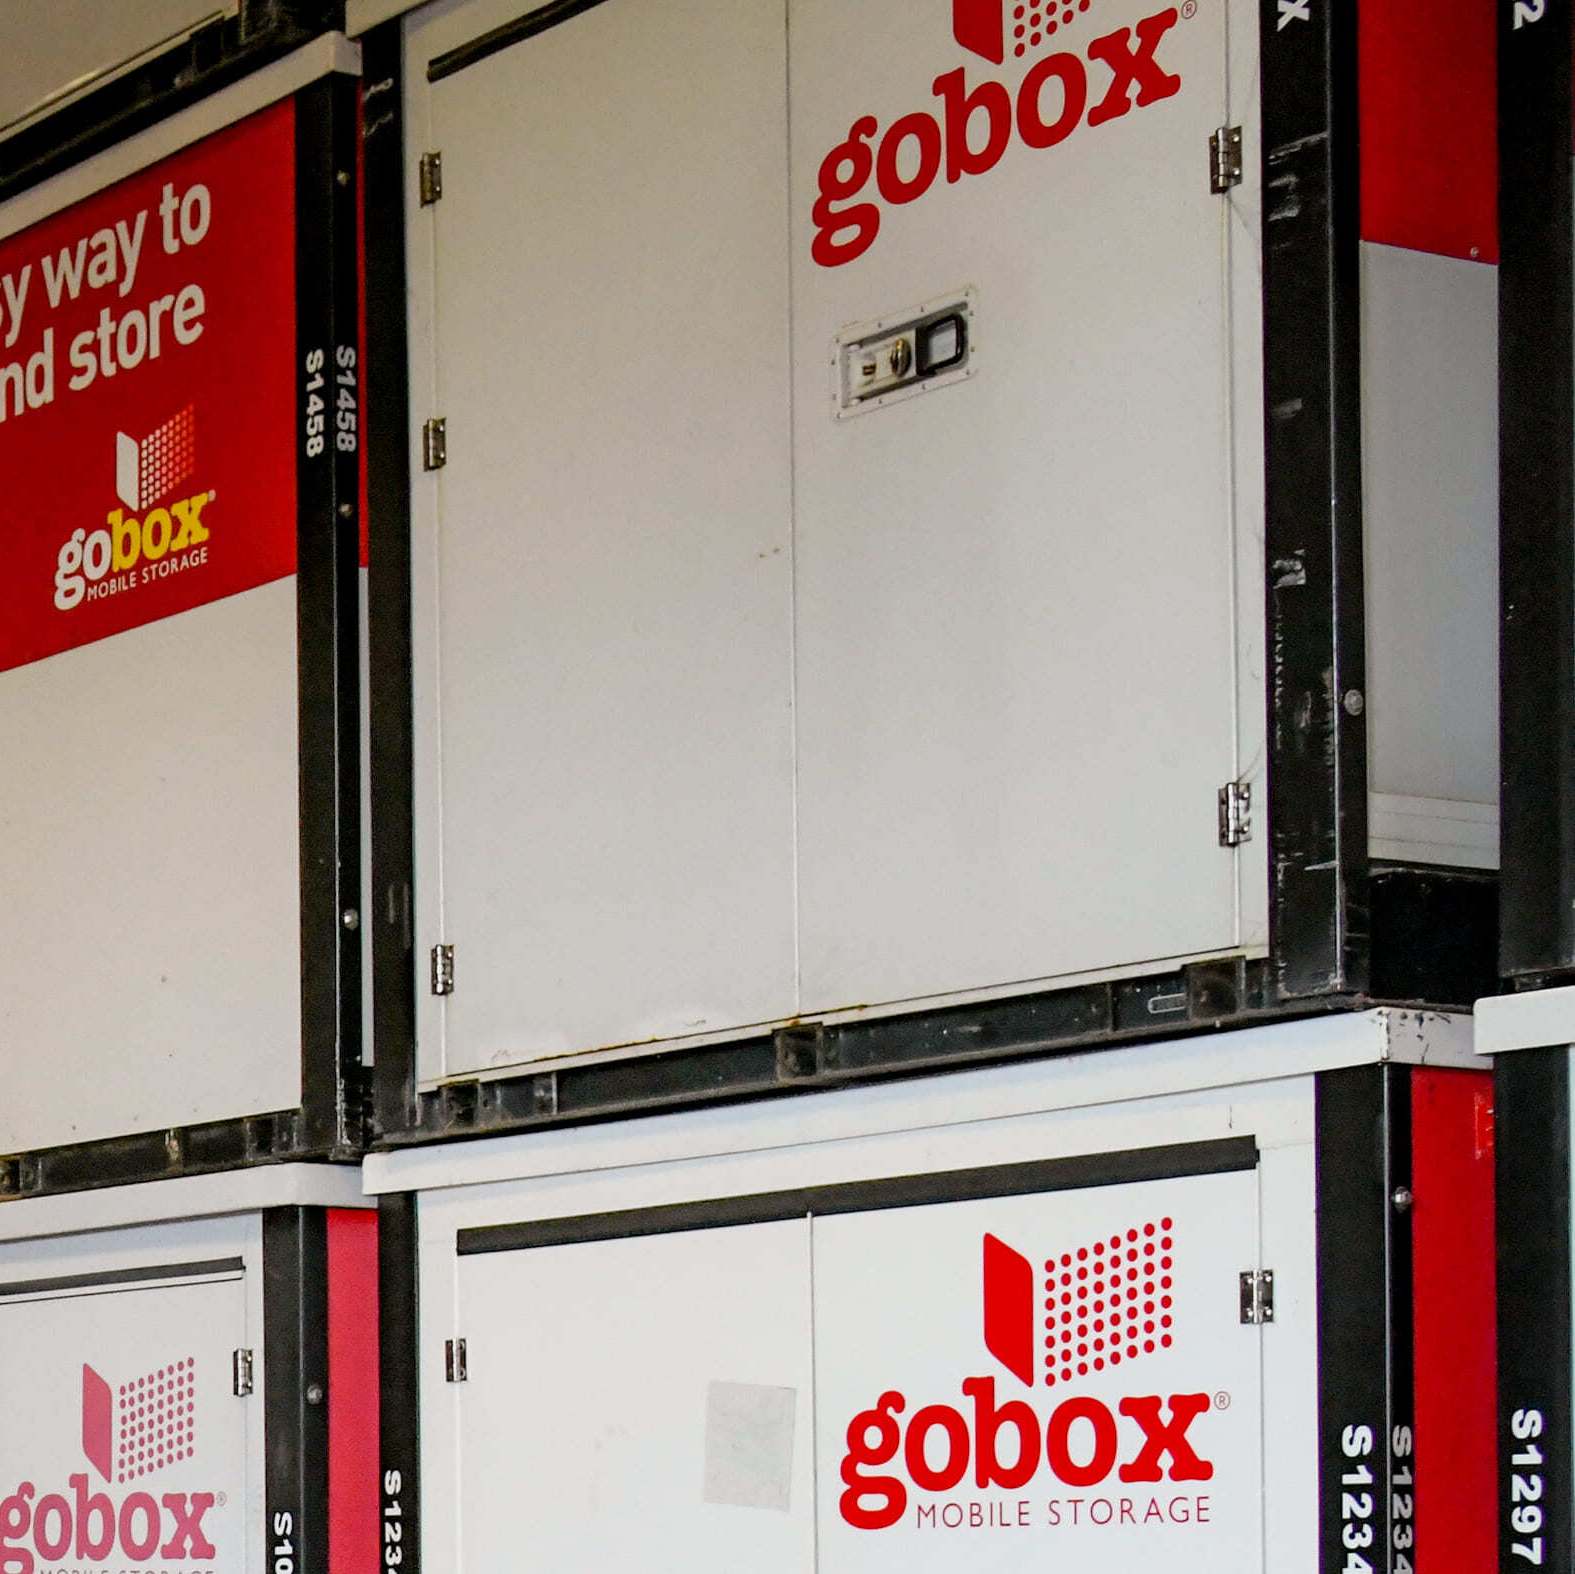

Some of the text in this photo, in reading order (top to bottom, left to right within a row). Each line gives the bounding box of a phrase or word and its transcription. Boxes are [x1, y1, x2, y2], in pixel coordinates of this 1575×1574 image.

[810, 7, 1182, 267] gobox
[41, 210, 148, 309] way
[160, 182, 211, 255] to
[68, 284, 205, 391] store
[305, 351, 324, 458] S1458
[337, 345, 356, 453] S1458
[54, 491, 210, 610] gobox
[87, 547, 208, 602] MOBILE STORAGE
[839, 1375, 1214, 1530] gobox
[1511, 1408, 1543, 1566] S1297
[916, 1496, 1211, 1529] MOBILE STORAGE
